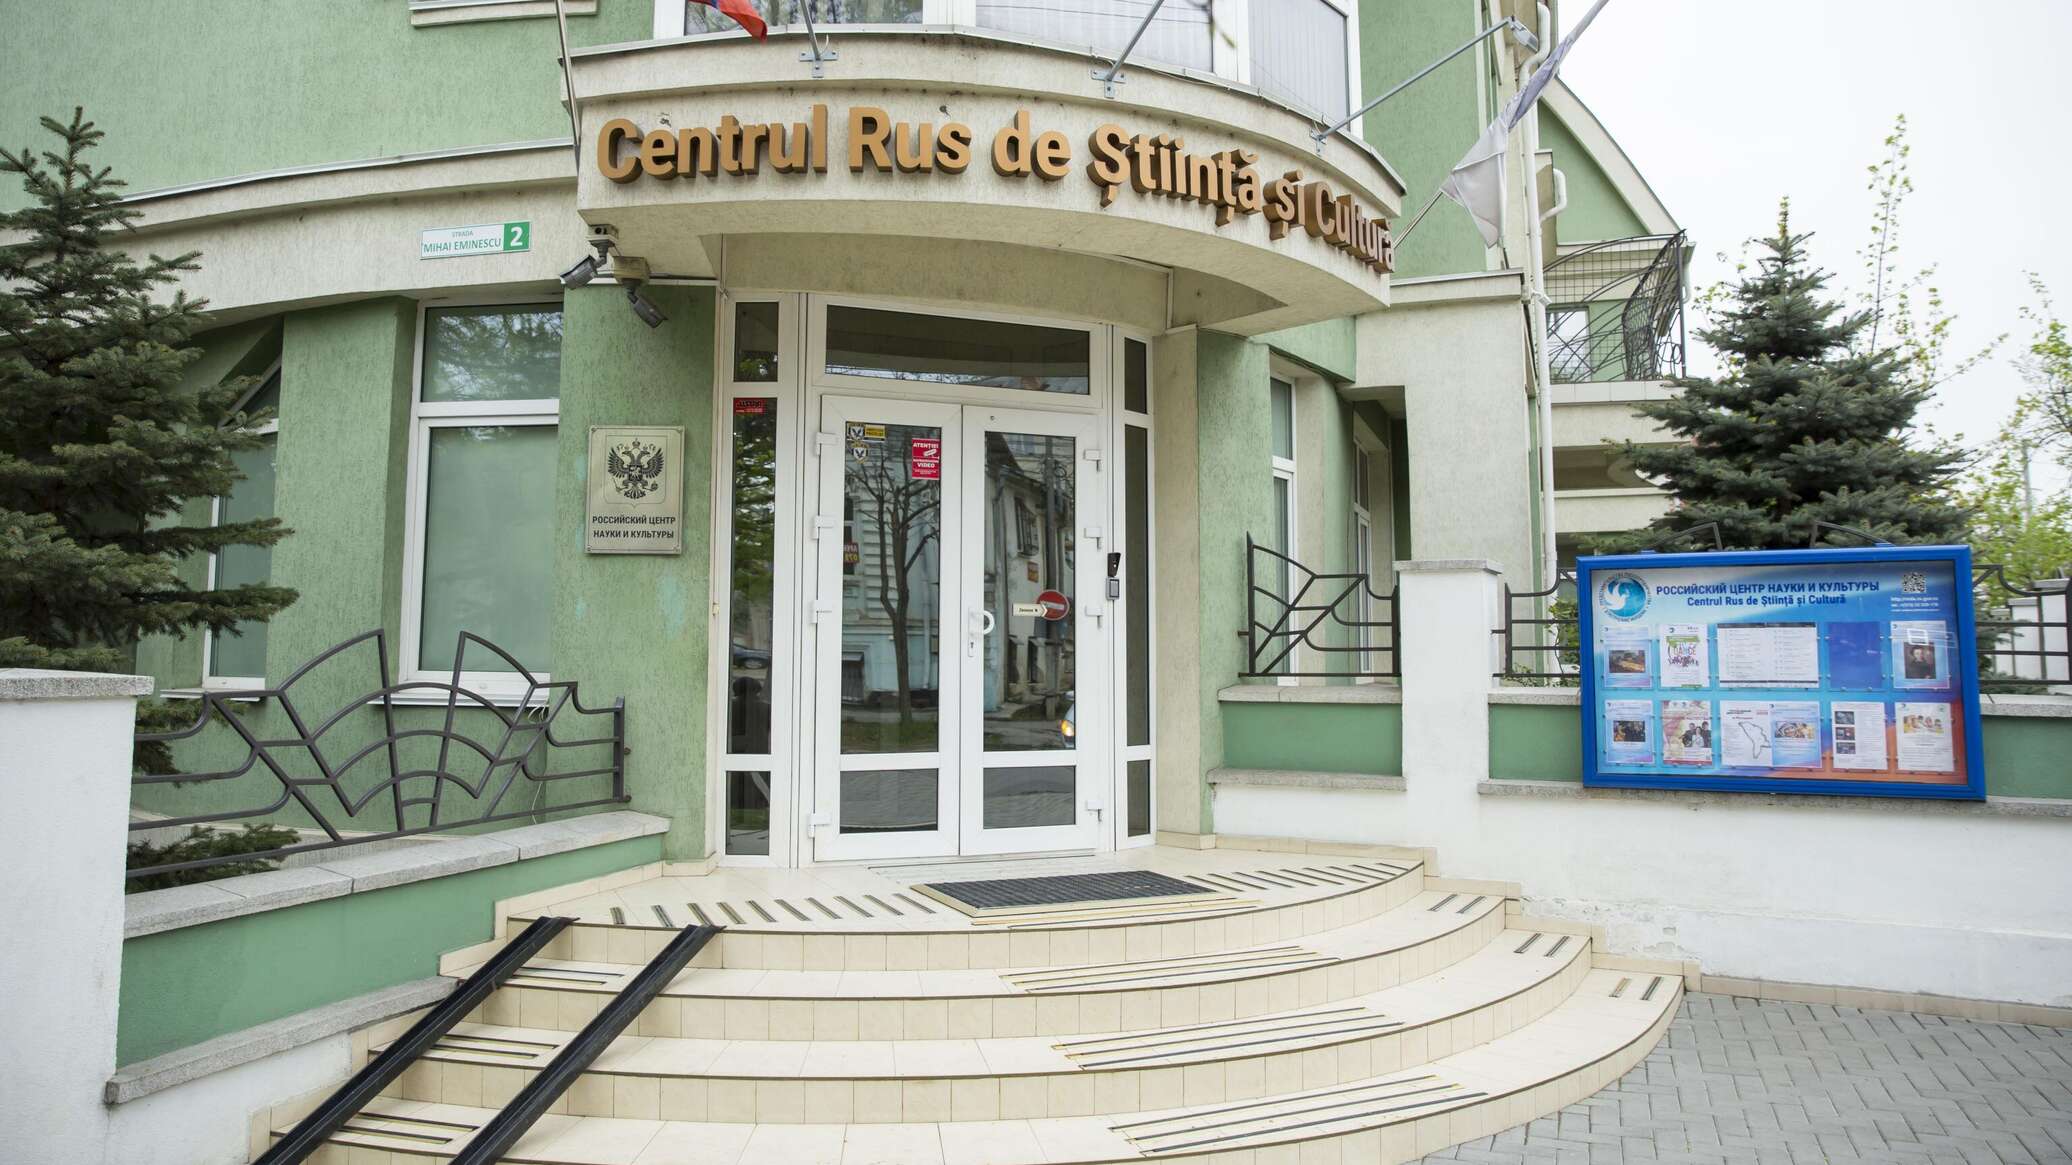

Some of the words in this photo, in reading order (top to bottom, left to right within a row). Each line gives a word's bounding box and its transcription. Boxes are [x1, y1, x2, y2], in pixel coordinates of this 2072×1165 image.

[597, 104, 828, 184] Centrul
[849, 106, 972, 174] Rus
[992, 109, 1072, 181] de
[1087, 123, 1262, 227] Știință
[1304, 181, 1395, 274] Cultură
[452, 230, 474, 238] STRADA
[510, 226, 523, 247] 2
[423, 242, 452, 253] MIHAI
[454, 238, 502, 251] EMINESCU
[592, 515, 647, 525] РОССИЙСКИЙ
[649, 517, 676, 526] ЦЕНТР
[593, 531, 622, 539] НАУКИ
[623, 530, 629, 539] И
[630, 530, 674, 539] КУЛЬТУРЫ
[1656, 583, 1727, 595] РОССИЙСКИЙ
[1730, 584, 1765, 595] ЦЕНТР
[1768, 583, 1805, 593] НАУКИ
[1808, 583, 1816, 592] И
[1819, 581, 1880, 592] КУЛЬТУРЫ
[1687, 596, 1722, 606] Centrul
[1725, 596, 1744, 606] Rus
[1746, 595, 1758, 606] de
[1808, 594, 1846, 605] Cultură
